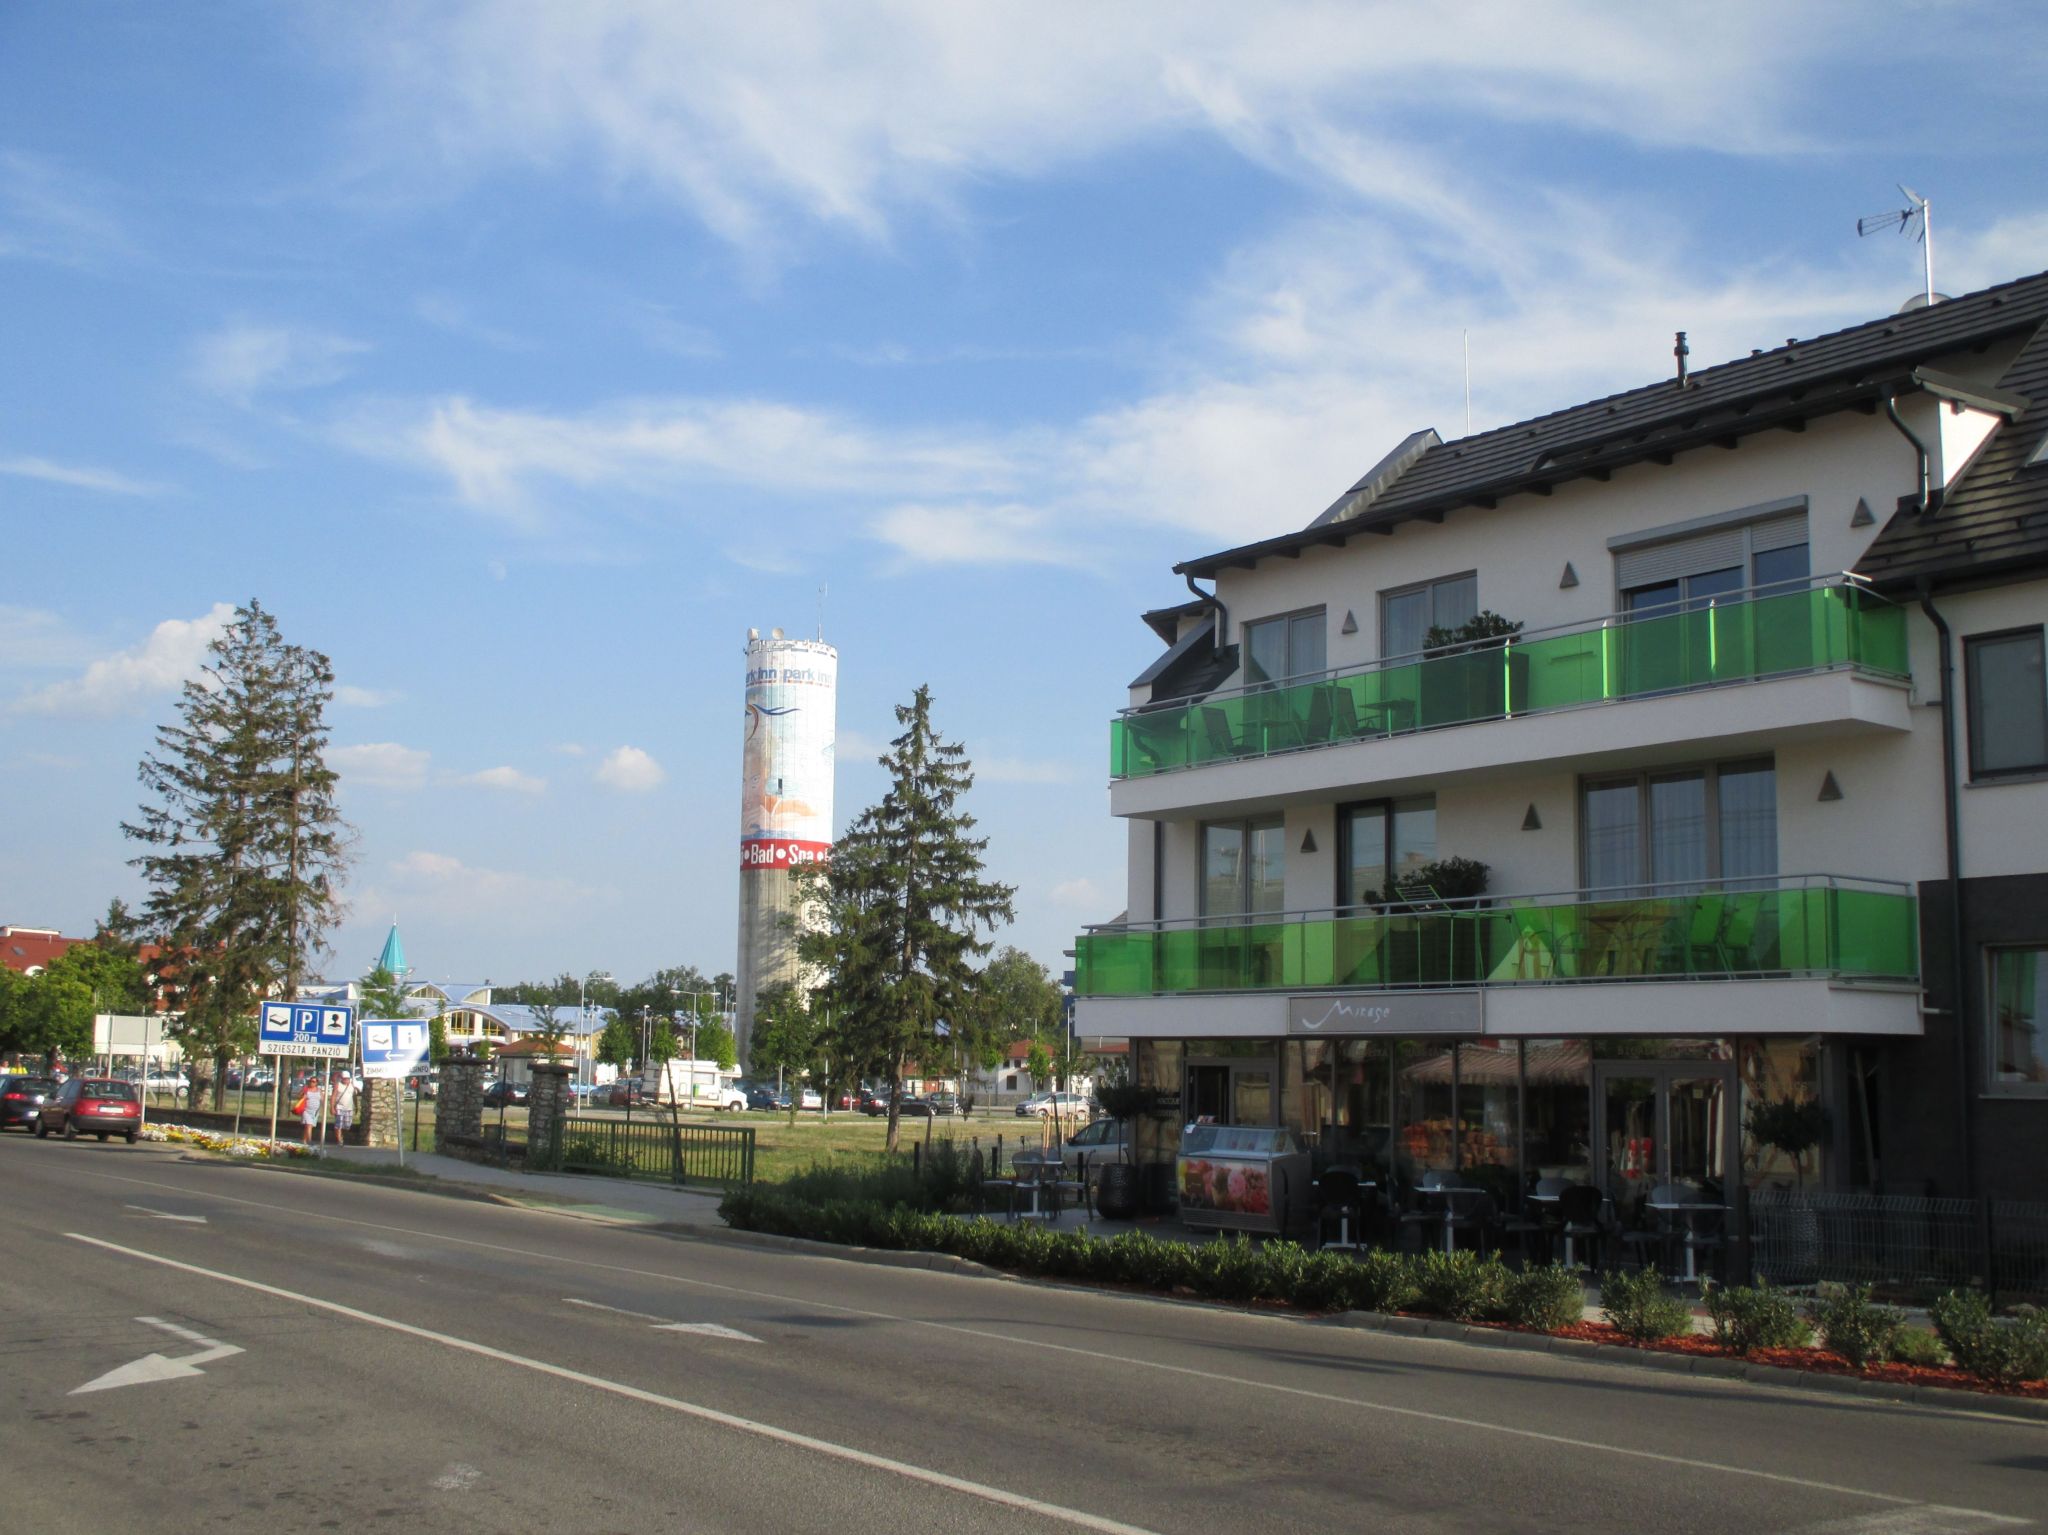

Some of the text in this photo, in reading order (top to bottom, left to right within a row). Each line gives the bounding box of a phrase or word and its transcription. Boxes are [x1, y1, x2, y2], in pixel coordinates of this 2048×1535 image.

[783, 668, 815, 683] park
[751, 843, 774, 865] Bad
[301, 1011, 313, 1031] P
[293, 1033, 310, 1042] 200
[267, 1043, 306, 1054] SZIESZTA
